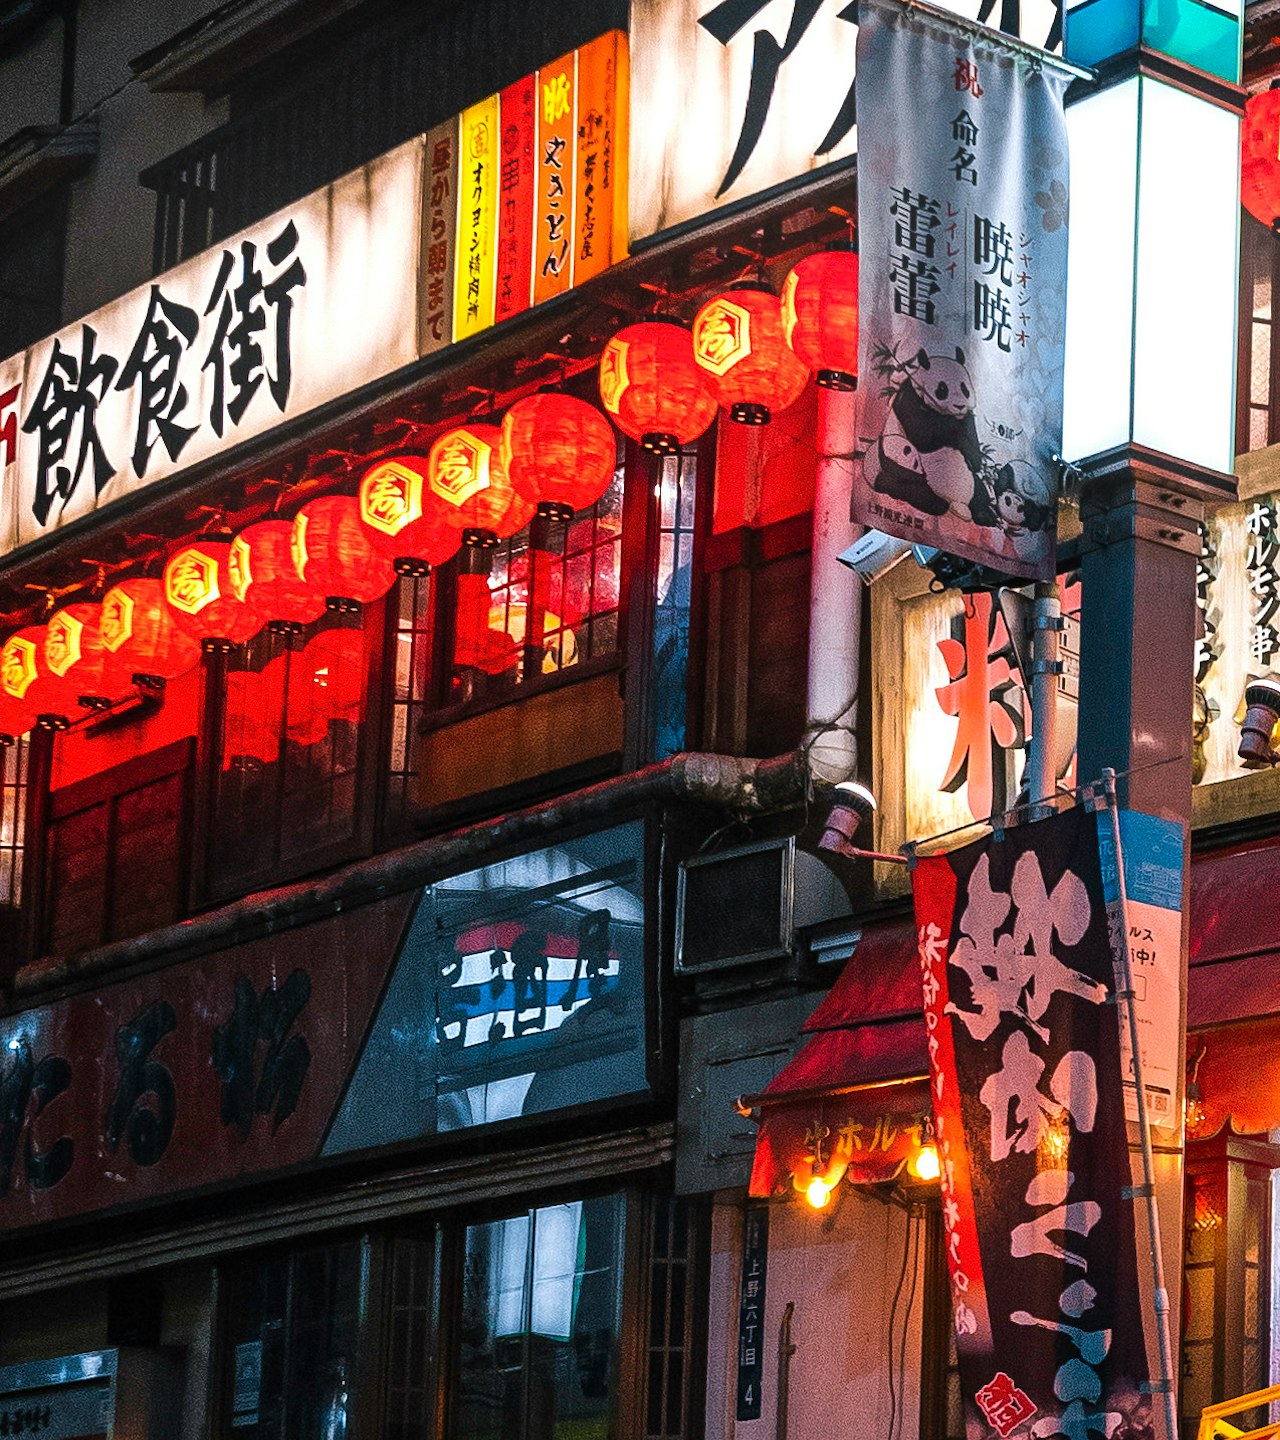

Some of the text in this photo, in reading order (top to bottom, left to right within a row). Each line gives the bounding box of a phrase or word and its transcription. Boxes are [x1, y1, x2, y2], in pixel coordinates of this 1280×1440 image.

[953, 59, 982, 98] 祝
[948, 109, 981, 186] 命名
[889, 187, 942, 325] 蕾蕾
[946, 202, 958, 277] レイレイ
[973, 213, 1014, 353] 暁暁
[1013, 234, 1034, 349] シャオシャオ
[1245, 502, 1280, 666] ホルモン串
[744, 1257, 763, 1368] 上野六丁目
